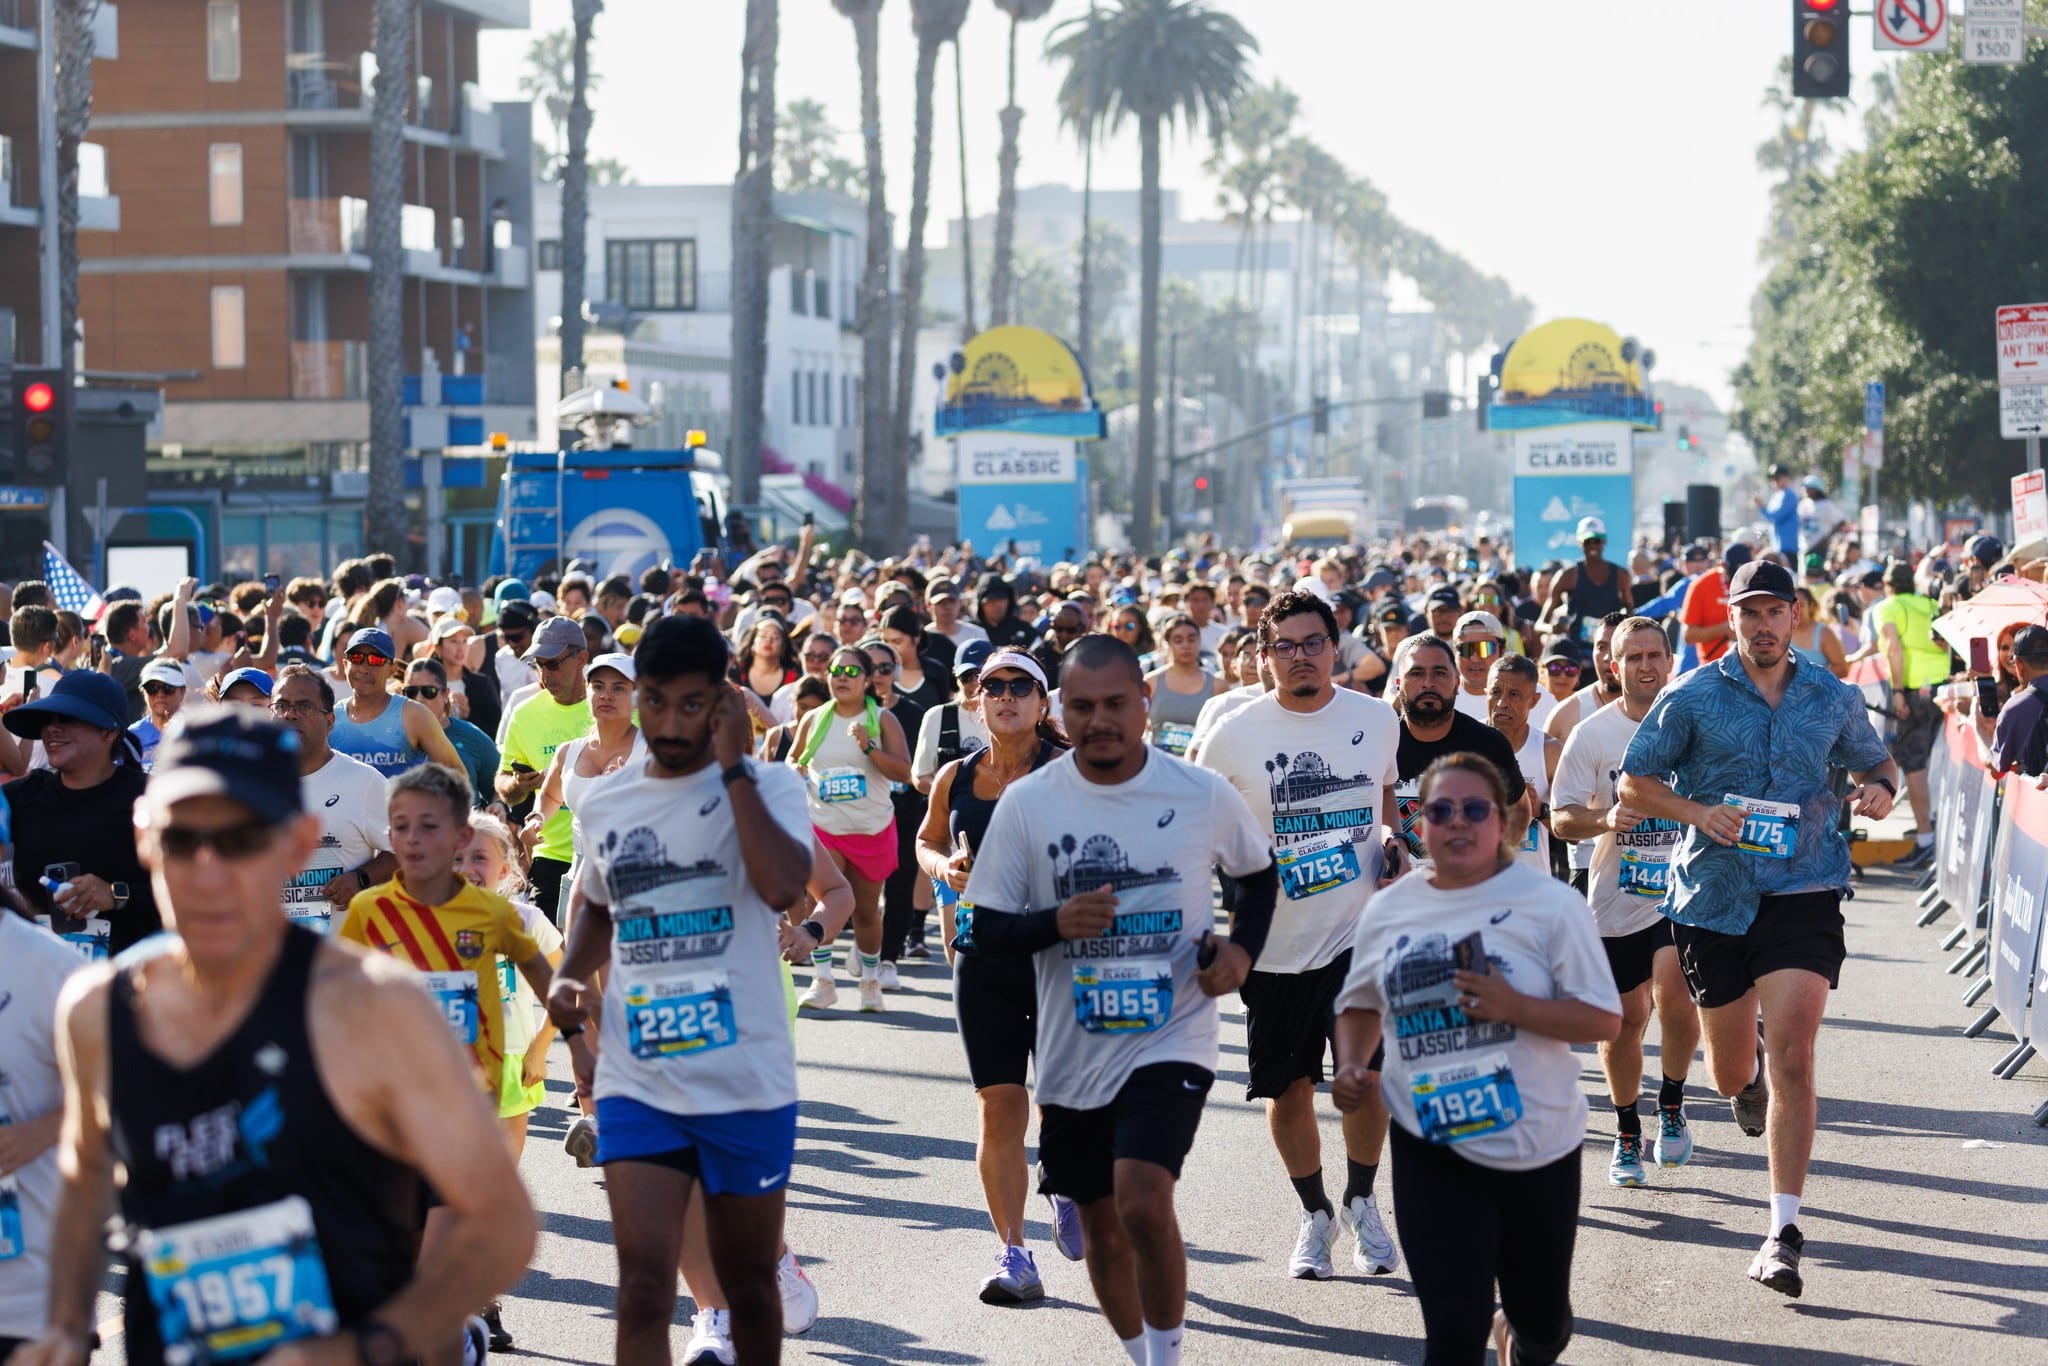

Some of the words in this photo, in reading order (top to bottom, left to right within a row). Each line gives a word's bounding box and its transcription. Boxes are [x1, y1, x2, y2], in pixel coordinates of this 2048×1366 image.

[1977, 42, 2010, 57] $500
[2003, 344, 2023, 357] ANY
[973, 459, 1061, 476] CLASSIC
[1529, 451, 1617, 467] CLASSIC
[824, 778, 859, 794] 1932
[1275, 814, 1320, 833] SANTA
[1322, 807, 1373, 829] MONICA
[1746, 805, 1777, 815] CLASSIC
[1298, 842, 1329, 856] CLASSIC
[1616, 833, 1660, 847] CLASSIC
[1290, 853, 1347, 887] 1752
[304, 887, 314, 897] 5K
[658, 907, 732, 937] MONICA
[1115, 910, 1182, 935] MONICA
[1063, 938, 1126, 960] CLASSIC
[1088, 987, 1159, 1017] 1855
[637, 999, 721, 1041] 2222
[1398, 1030, 1466, 1062] CLASSIC
[1430, 1083, 1503, 1125] 1921
[173, 1254, 295, 1332] 1957
